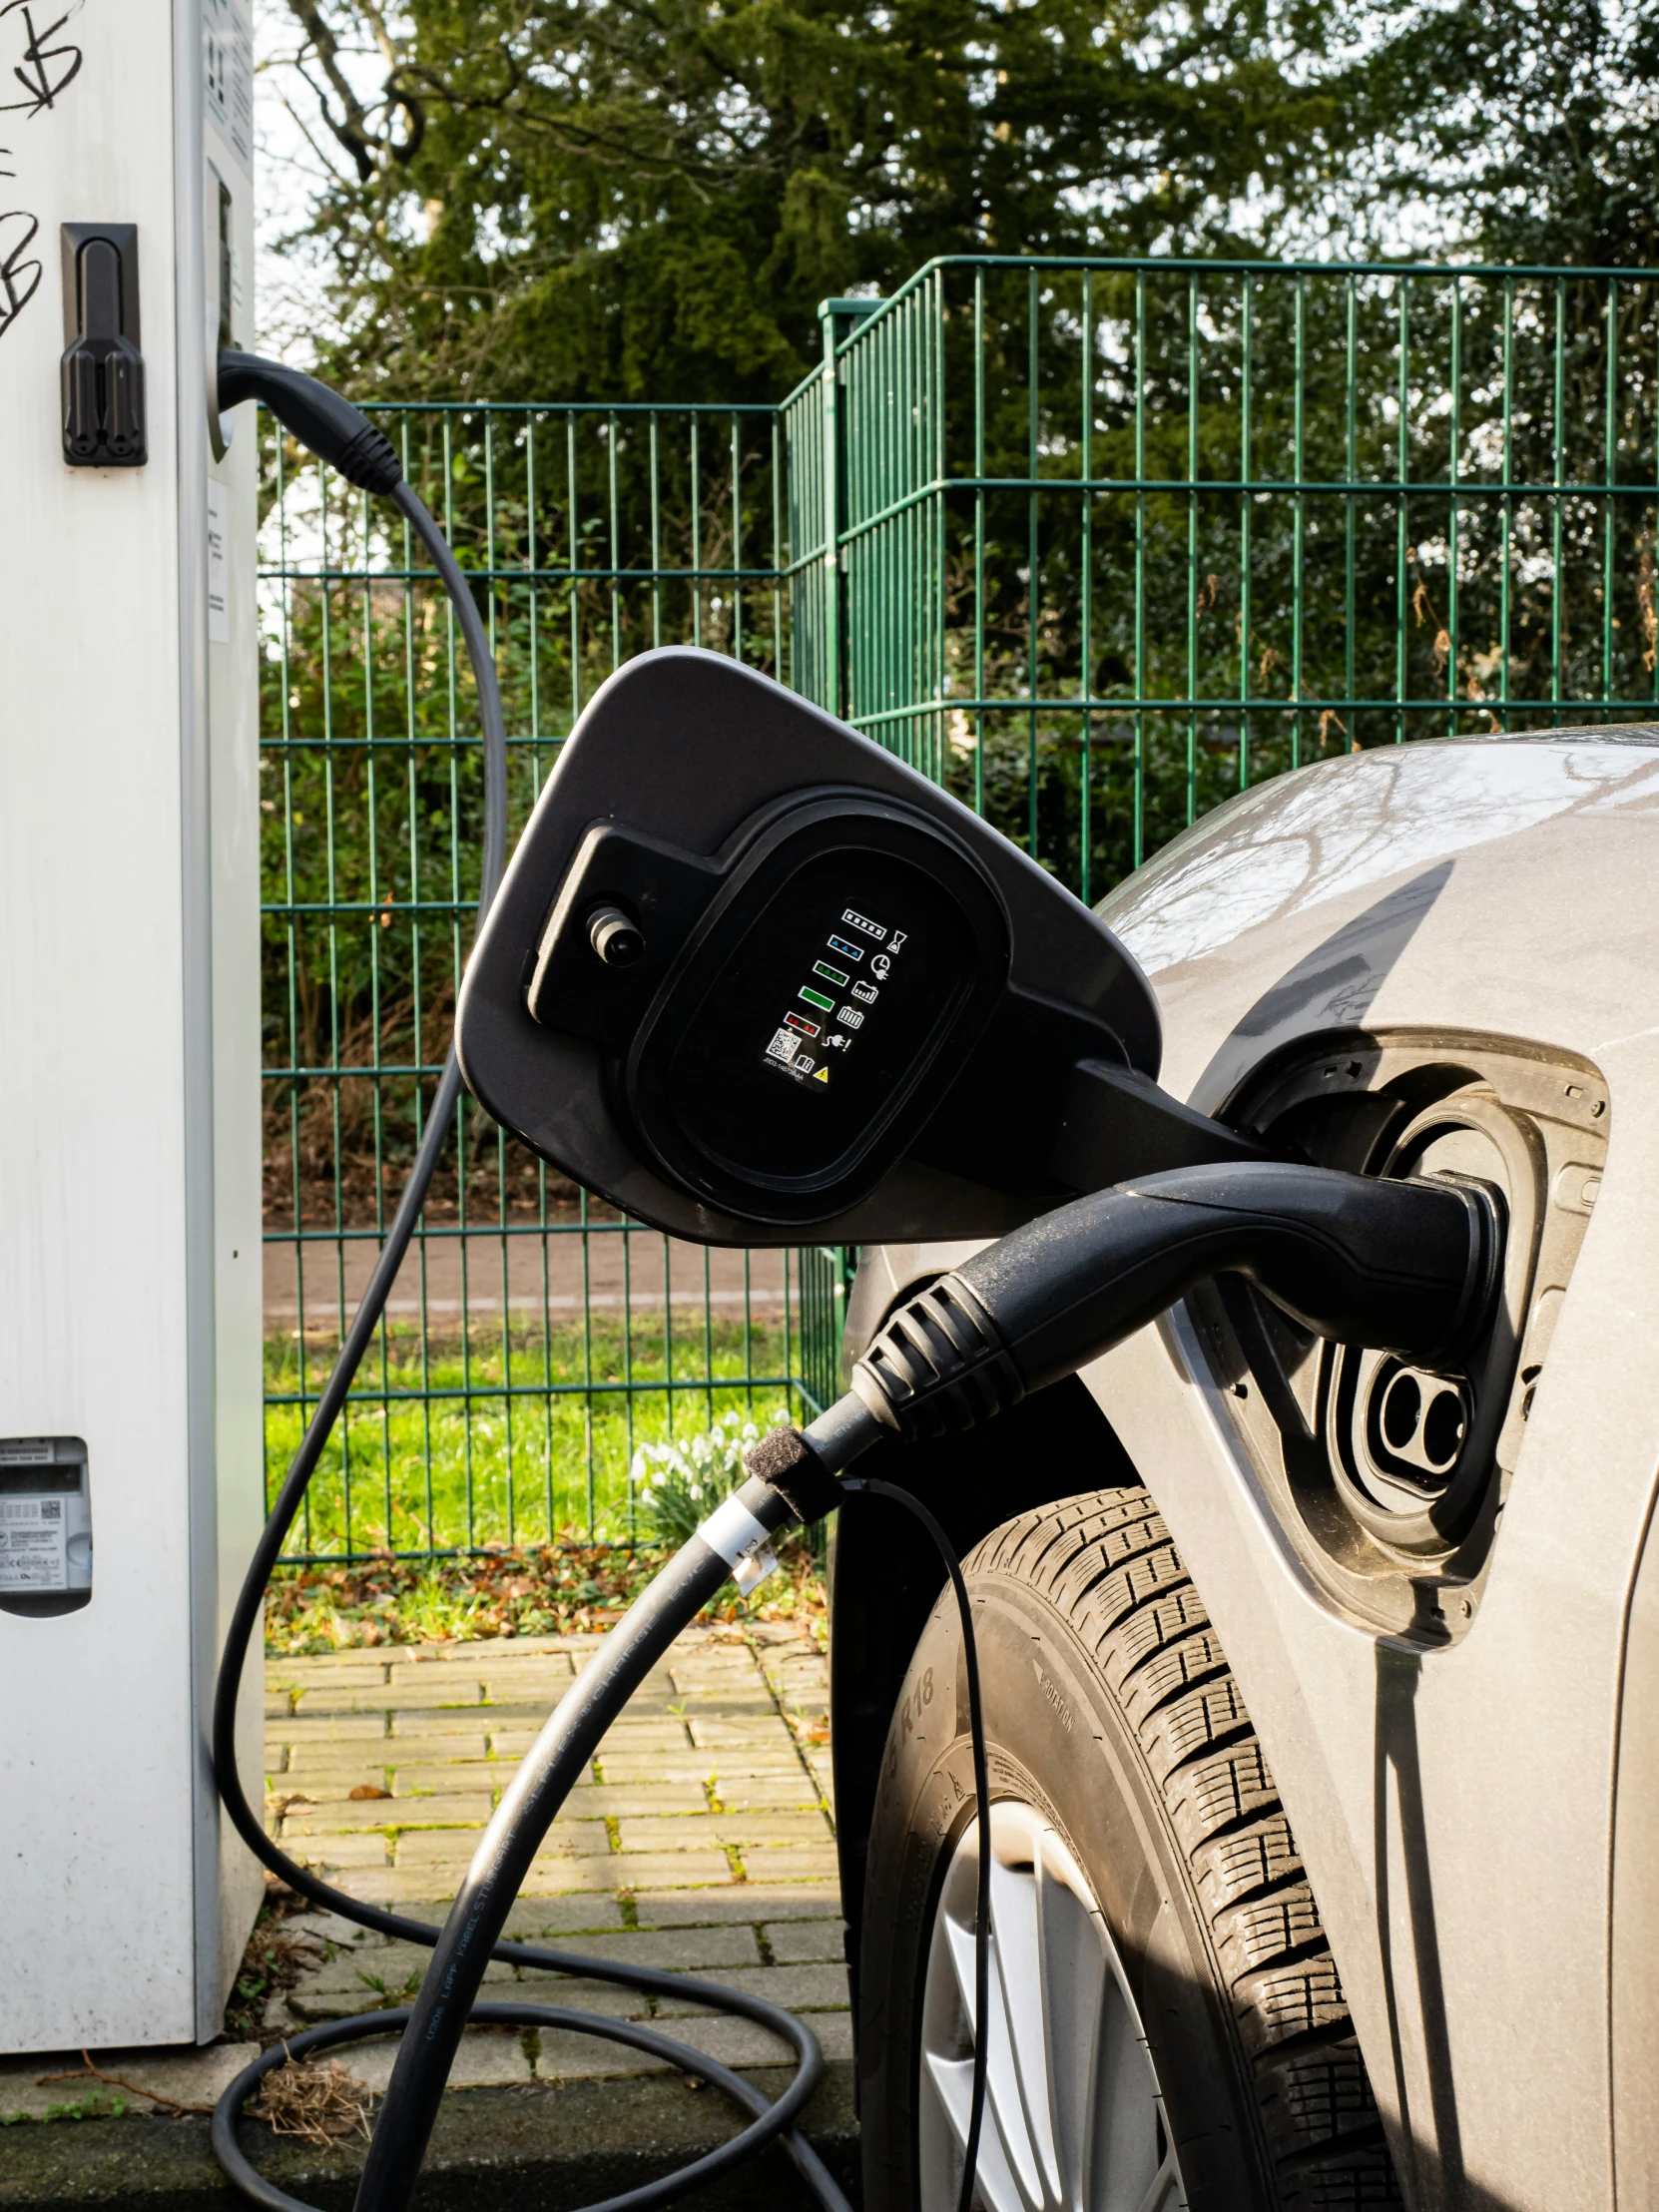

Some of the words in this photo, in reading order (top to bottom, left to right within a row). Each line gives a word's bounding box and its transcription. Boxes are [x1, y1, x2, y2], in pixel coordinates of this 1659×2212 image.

[1042, 1677, 1076, 1734] ROTATION
[439, 1962, 457, 1998] LAPP
[455, 1915, 480, 1955] KABEL
